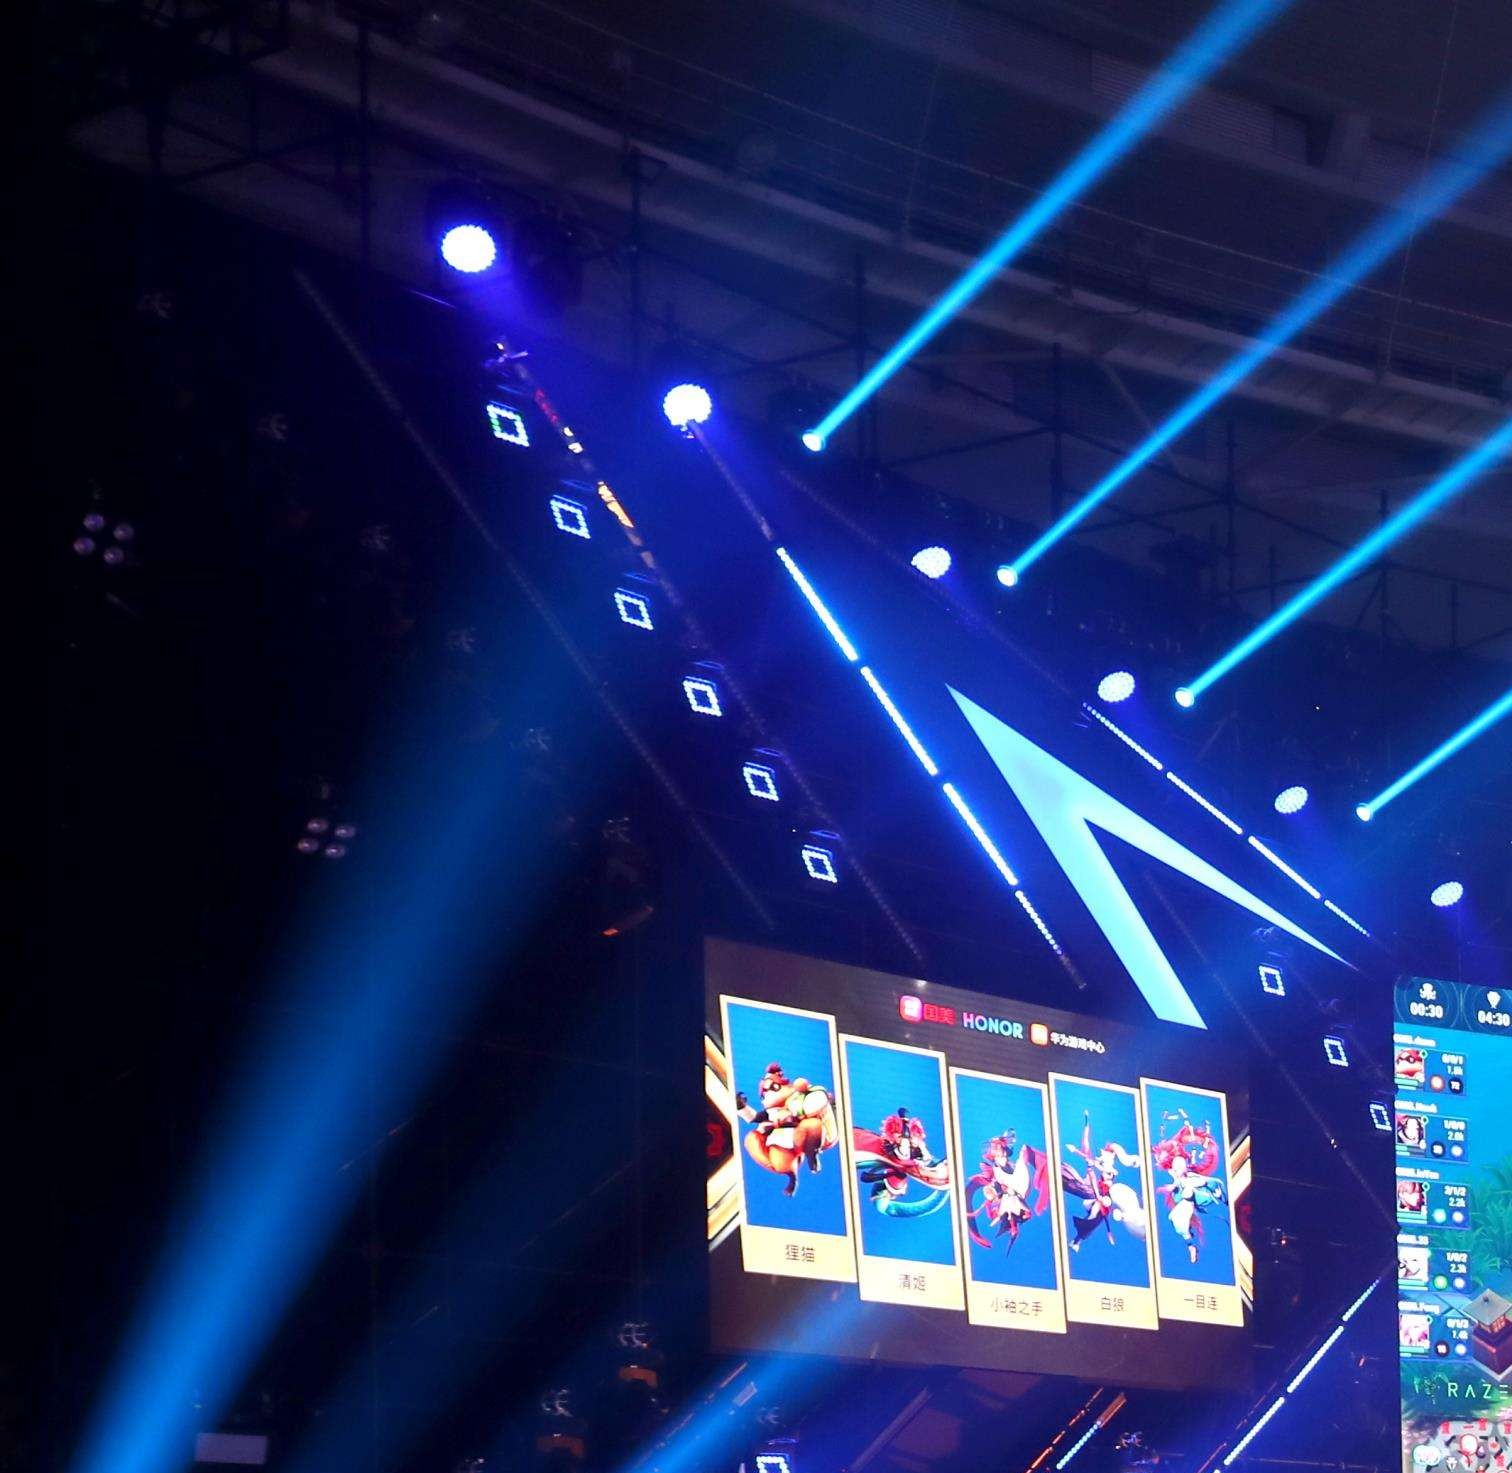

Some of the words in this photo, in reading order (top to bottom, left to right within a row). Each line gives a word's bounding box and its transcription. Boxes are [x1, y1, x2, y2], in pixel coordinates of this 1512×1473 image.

[1409, 1002, 1444, 1018] 00:30
[1477, 1010, 1511, 1026] 04:30
[962, 1012, 1024, 1039] HONOR
[785, 1243, 815, 1263] 狸猫
[990, 1296, 1043, 1317] 小袖之手
